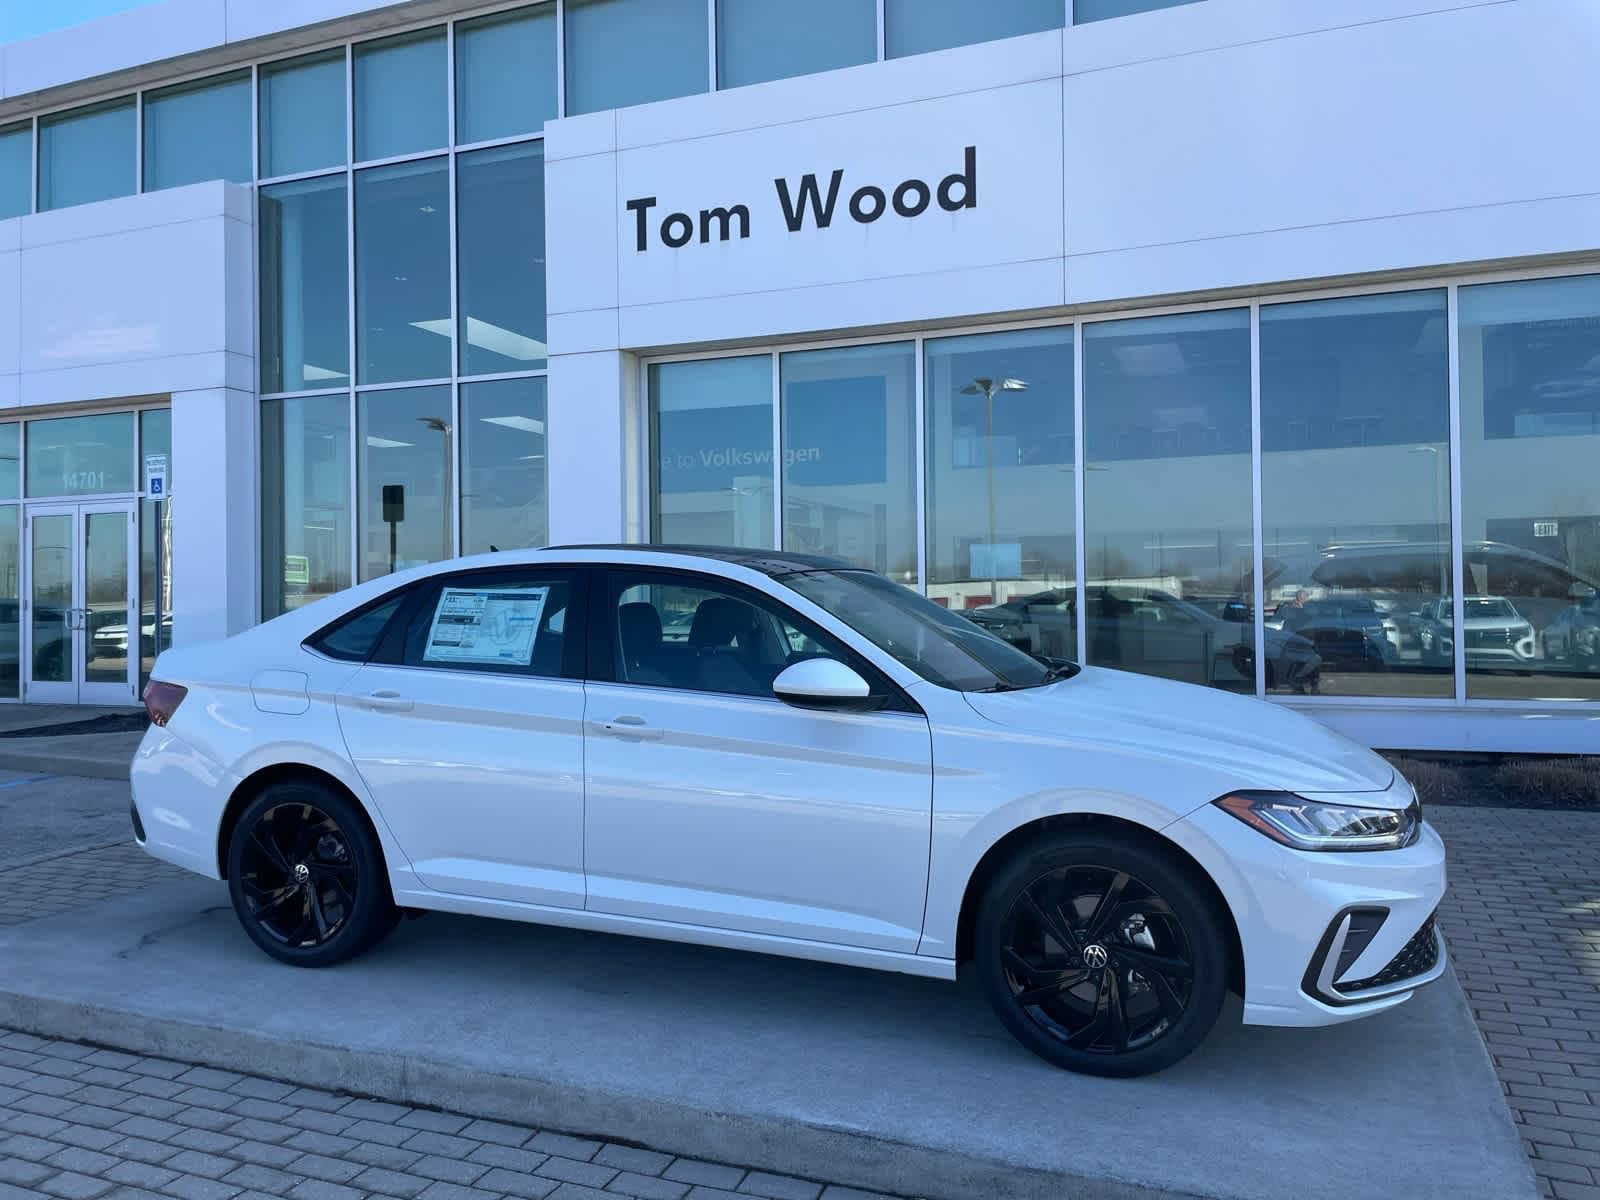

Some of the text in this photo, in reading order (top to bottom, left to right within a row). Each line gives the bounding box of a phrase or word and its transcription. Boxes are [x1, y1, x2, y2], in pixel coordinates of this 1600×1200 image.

[626, 145, 977, 252] Tom Wood
[699, 446, 822, 467] Volkswgen
[62, 471, 104, 489] 14701
